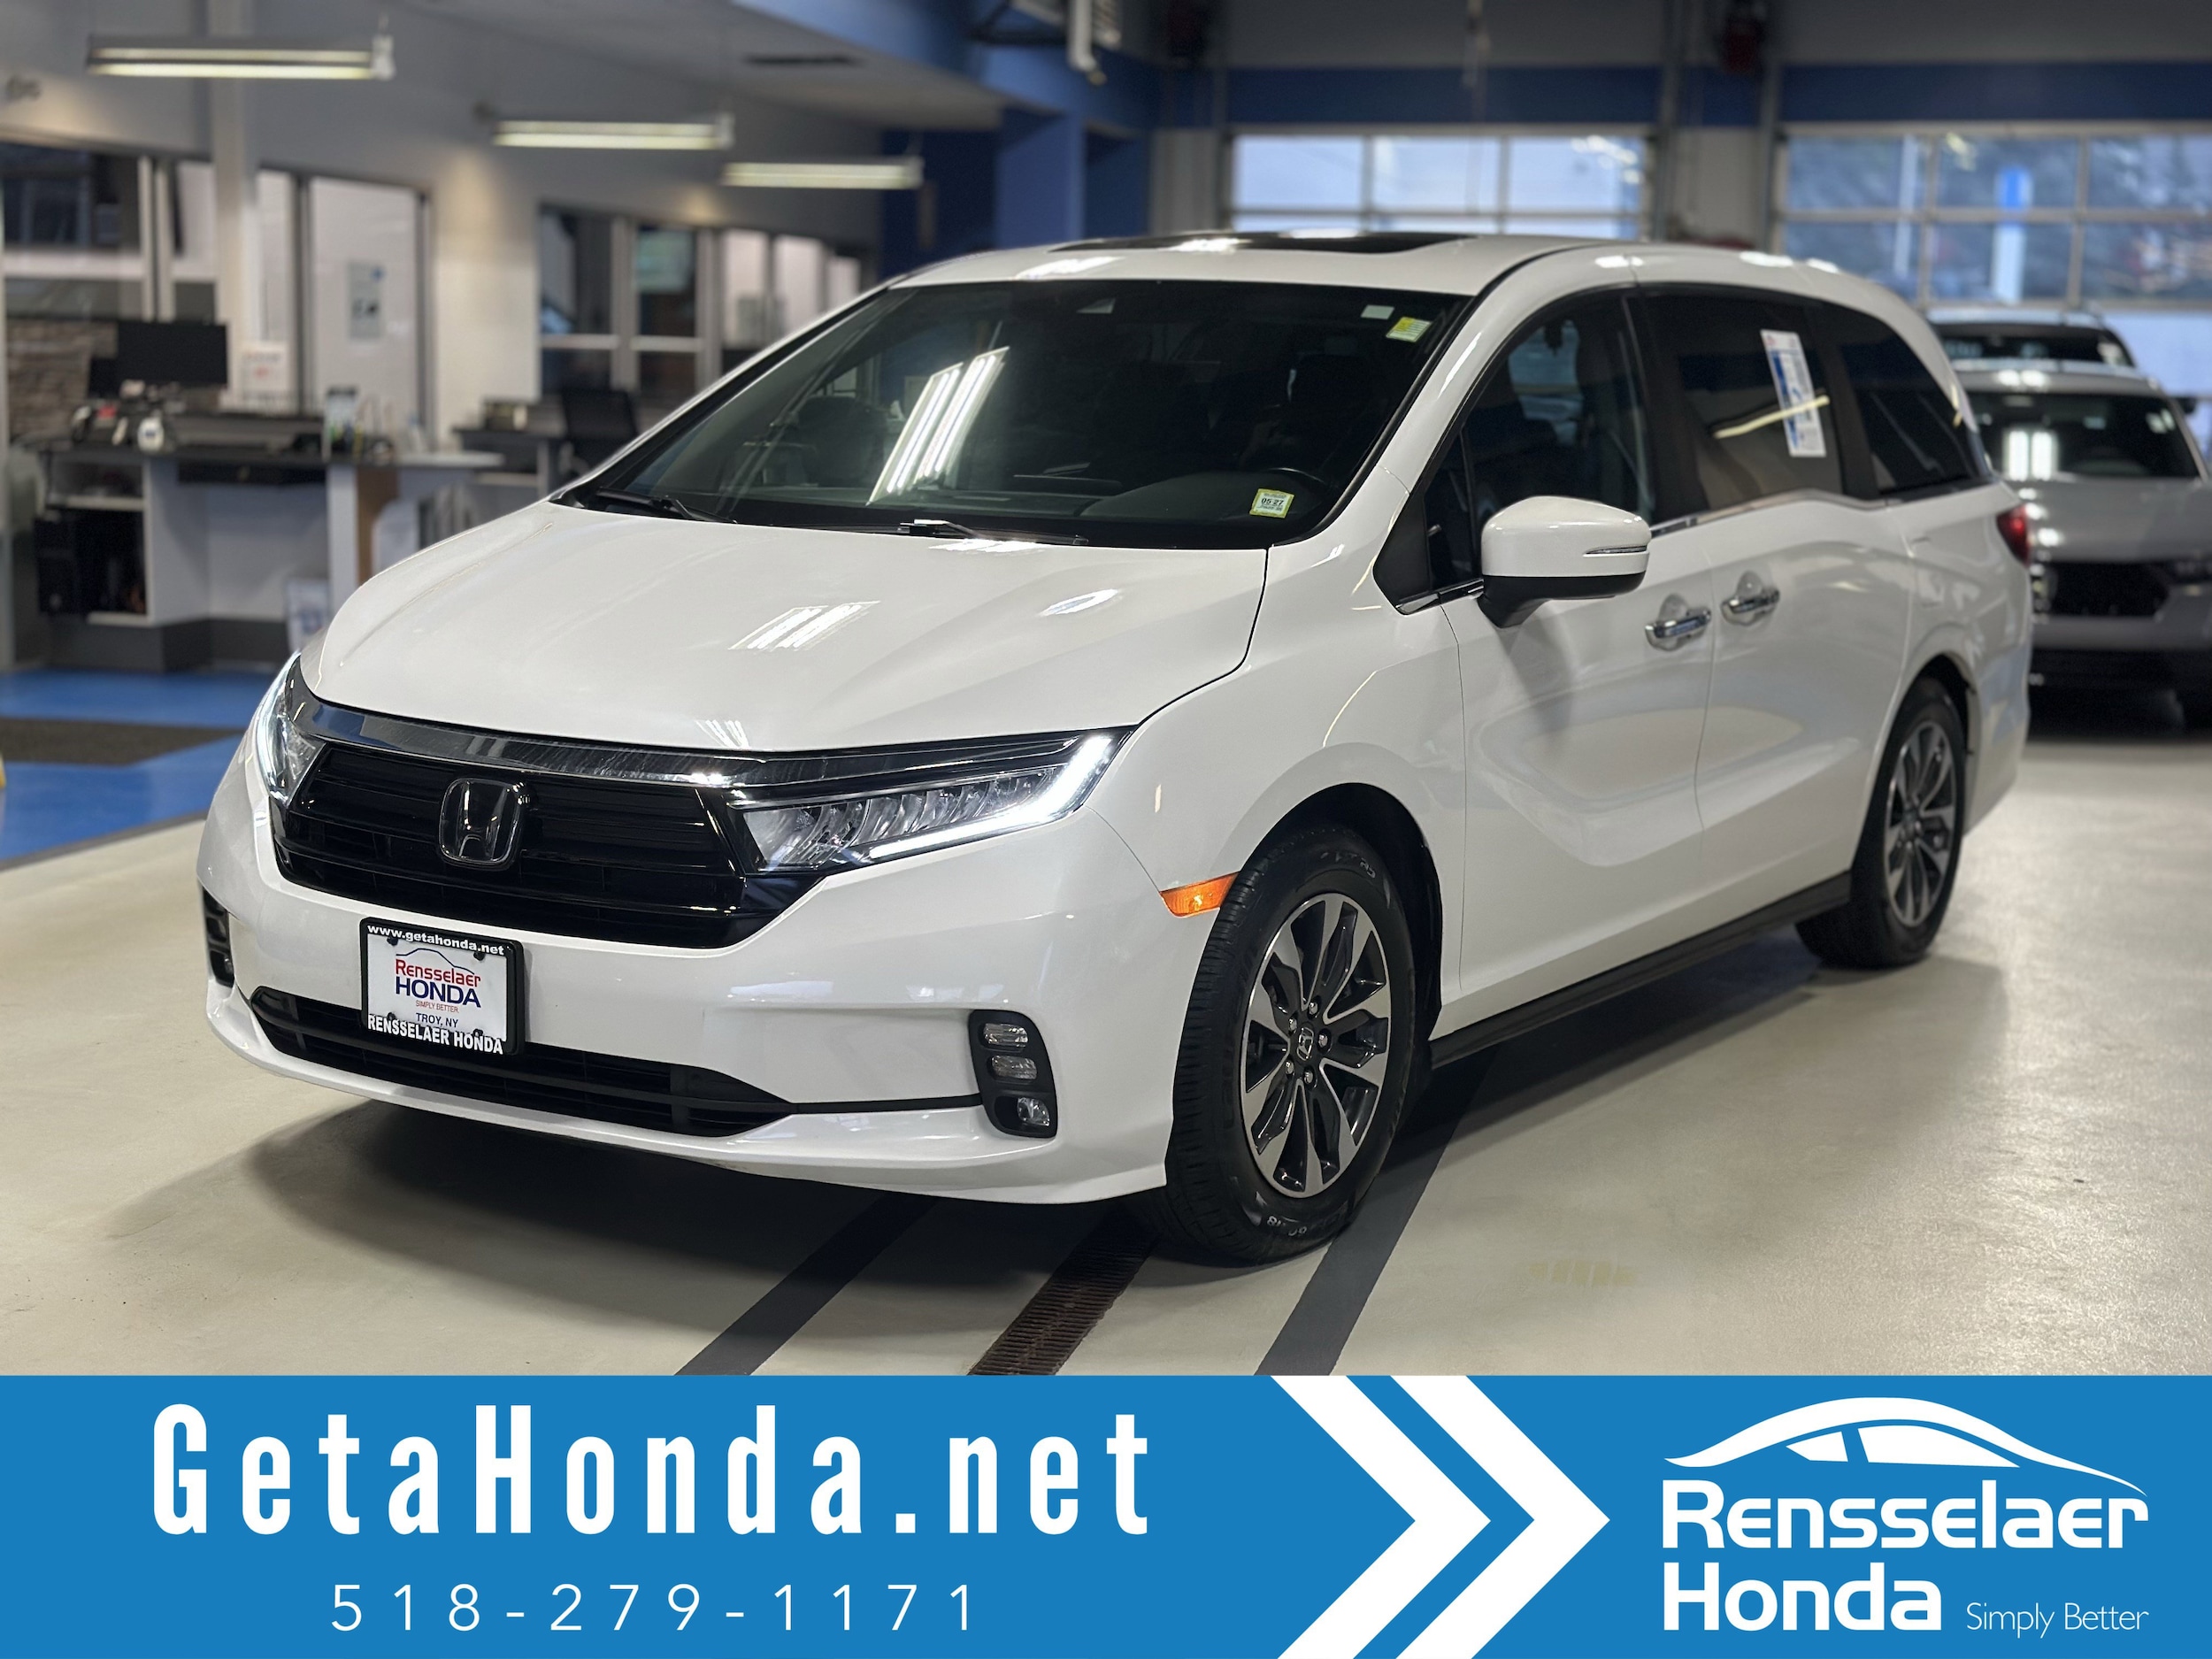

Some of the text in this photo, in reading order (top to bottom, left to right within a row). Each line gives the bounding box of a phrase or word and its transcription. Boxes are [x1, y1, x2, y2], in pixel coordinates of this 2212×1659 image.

[367, 925, 504, 956] www.getahonda.net
[396, 958, 481, 987] Rensselaer
[396, 976, 481, 1008] HONDA
[416, 1000, 435, 1010] SIMPLY
[368, 1014, 503, 1055] RENSSELAER HONDA
[416, 1012, 458, 1028] TROY, NY
